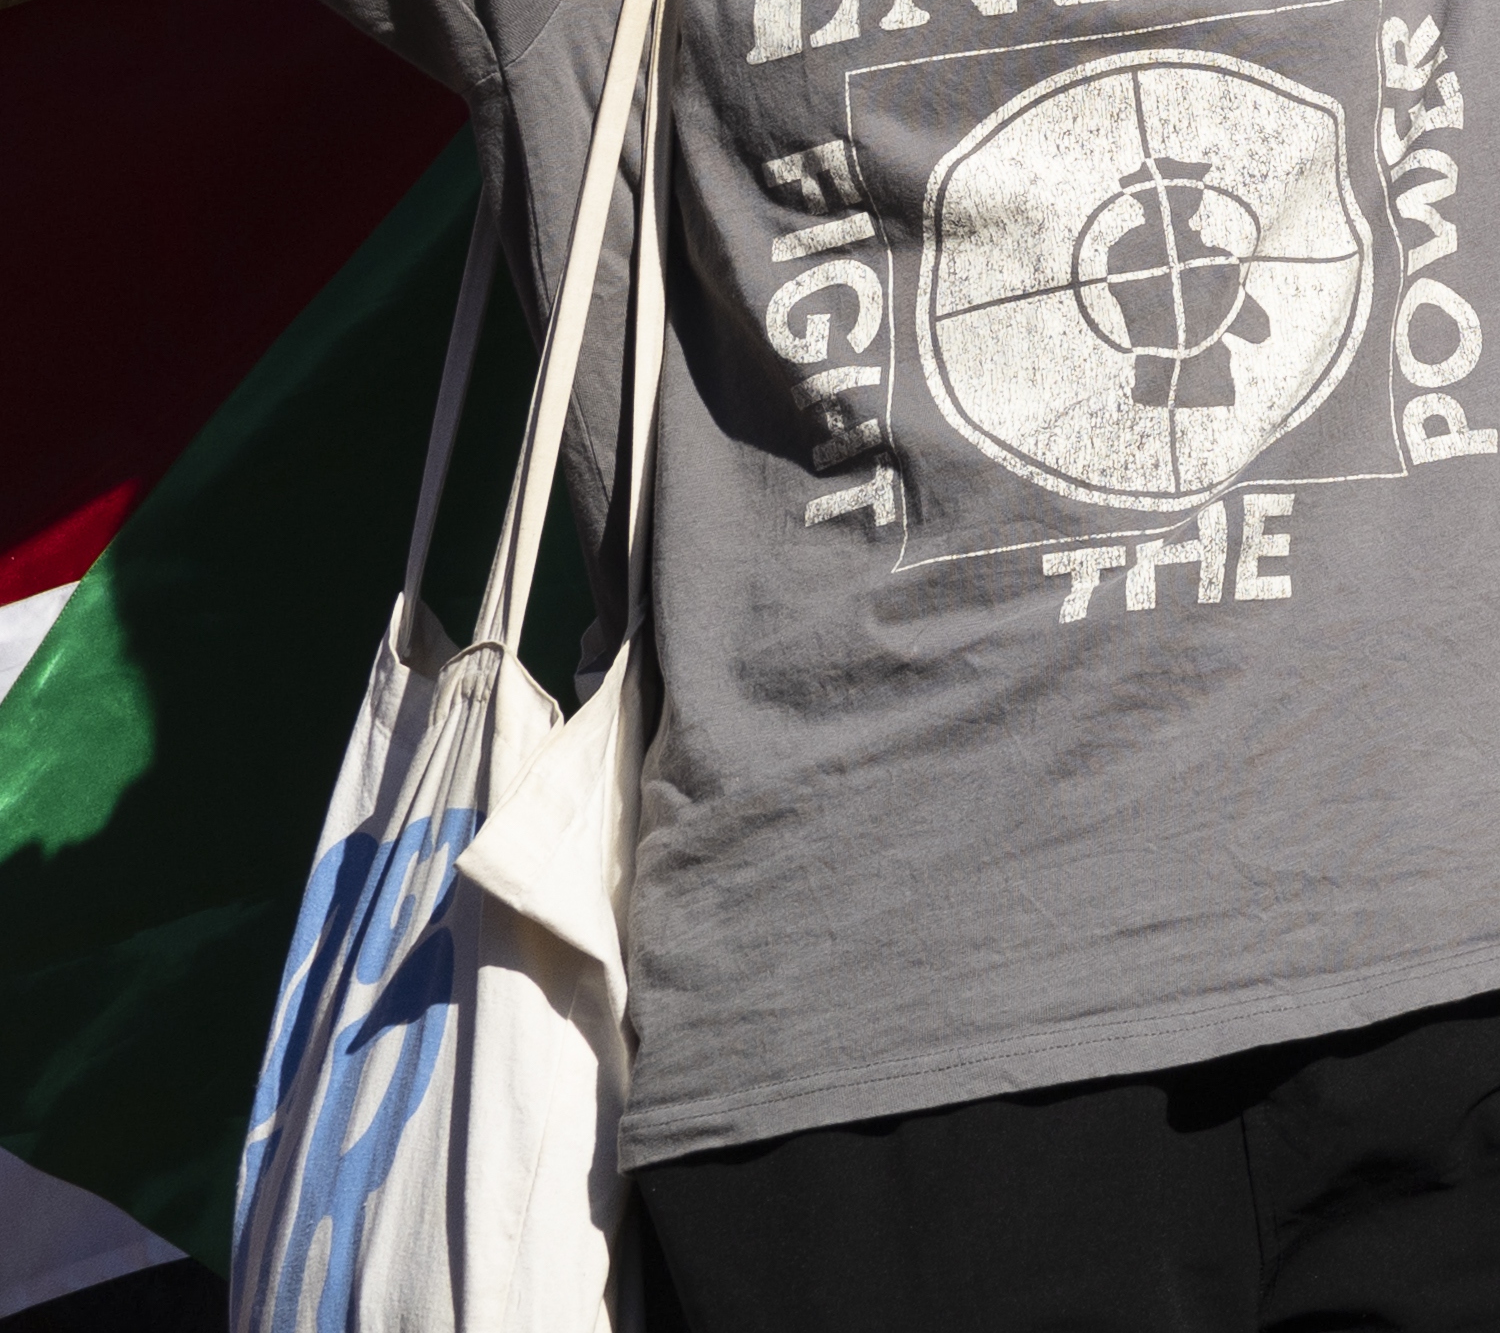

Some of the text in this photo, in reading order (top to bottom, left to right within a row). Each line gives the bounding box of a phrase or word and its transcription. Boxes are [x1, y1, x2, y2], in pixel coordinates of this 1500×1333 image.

[761, 139, 897, 528] FIGHT
[1381, 15, 1498, 465] POWER
[1043, 493, 1294, 624] THE
